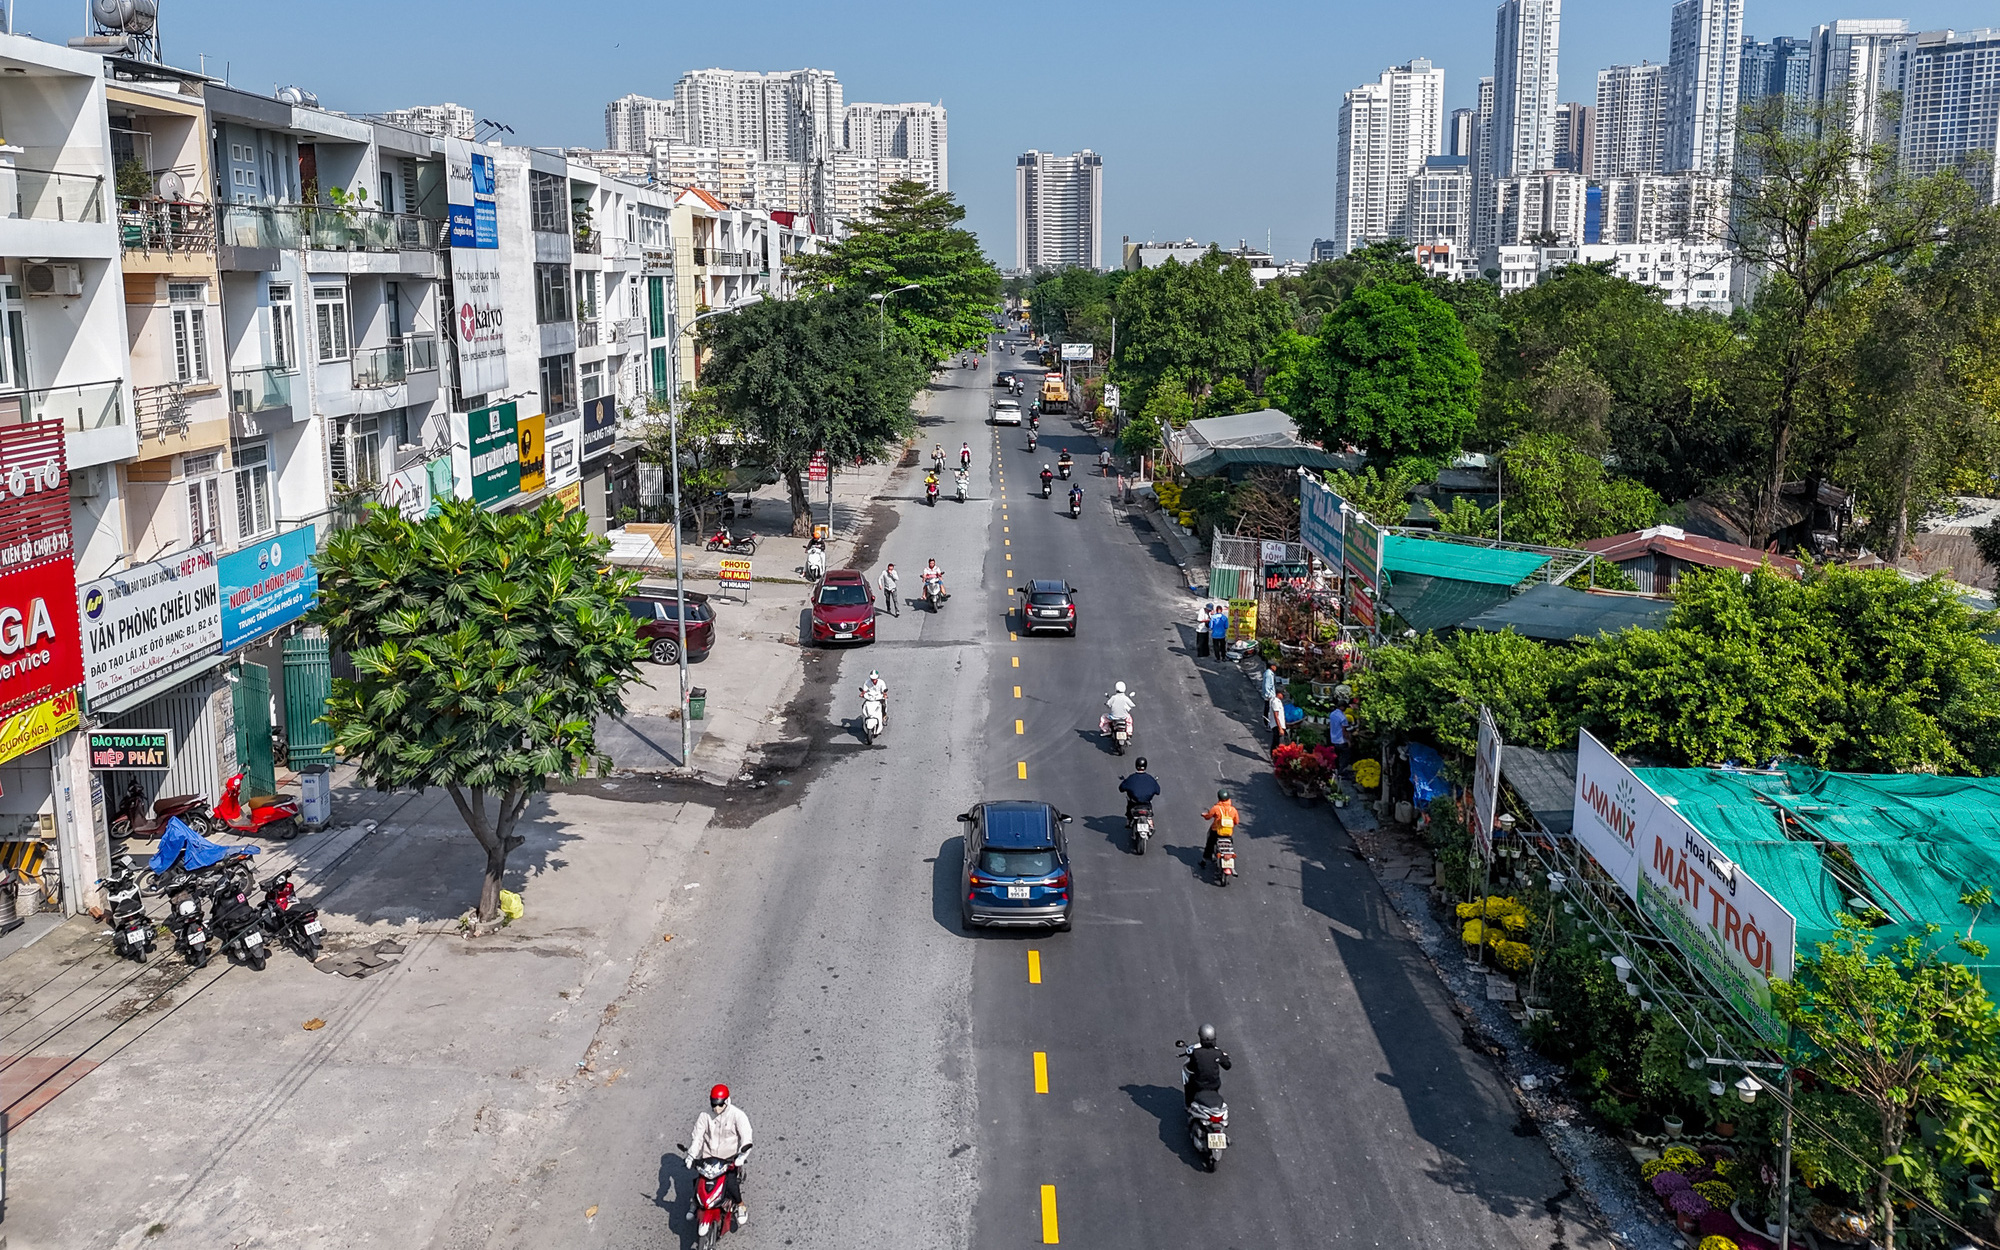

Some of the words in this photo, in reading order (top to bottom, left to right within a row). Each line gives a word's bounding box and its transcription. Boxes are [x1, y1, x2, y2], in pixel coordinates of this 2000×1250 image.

[474, 303, 502, 334] kaiyo
[1, 543, 20, 567] KIỆN
[1266, 542, 1282, 551] Cafe
[108, 583, 121, 601] TRUNG
[181, 554, 196, 578] HIỆP
[197, 547, 214, 570] PHÁT
[724, 560, 750, 569] PHOTO
[229, 586, 252, 610] NƯỚC
[253, 578, 263, 599] ĐÁ
[265, 571, 285, 594] HỒNG
[286, 563, 305, 584] PHÚC
[728, 581, 750, 589] NHANH
[89, 621, 116, 654] VĂN
[119, 606, 157, 640] PHÒNG
[160, 590, 191, 626] CHIÊU
[195, 583, 217, 612] SINH
[238, 616, 256, 630] TRUNG
[256, 608, 267, 622] TÂM
[267, 603, 281, 617] PHÂN
[91, 662, 106, 678] ĐÀO
[109, 657, 124, 671] TẠO
[125, 650, 137, 663] LÁI
[139, 644, 148, 658] XE
[165, 630, 185, 645] HẠNG:
[187, 624, 197, 636] B1,
[198, 619, 206, 631] B2
[214, 614, 218, 624] C
[0, 650, 50, 681] ervice
[52, 691, 76, 718] 3M
[31, 723, 49, 739] NGA
[54, 718, 77, 735] AutoFilm
[91, 734, 113, 747] ĐÀO
[113, 736, 133, 748] TẠO
[135, 734, 151, 747] LÁI
[152, 736, 165, 747] XE
[94, 748, 124, 767] HIỆP
[128, 748, 164, 765] PHÁT
[1581, 773, 1636, 850] LAVAMIX
[1685, 831, 1705, 863] Hoa
[1653, 835, 1705, 910] MẶT
[1709, 884, 1773, 980] TRỜI
